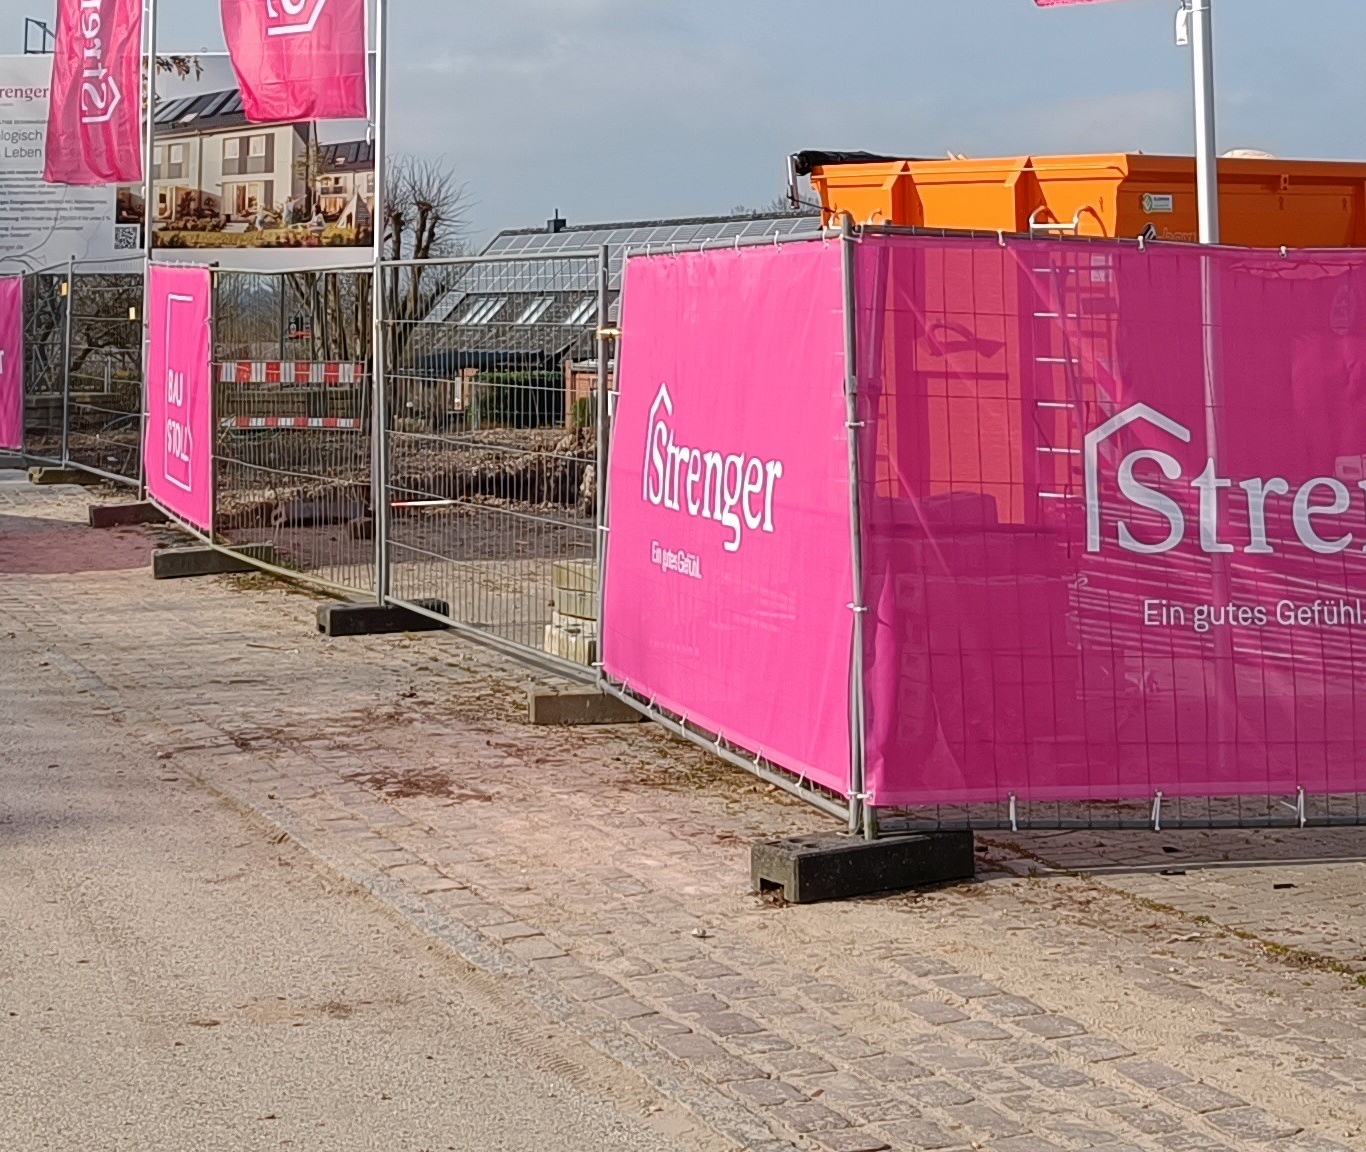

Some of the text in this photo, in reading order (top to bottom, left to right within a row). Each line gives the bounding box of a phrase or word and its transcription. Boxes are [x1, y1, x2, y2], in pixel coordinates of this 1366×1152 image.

[5, 146, 42, 158] Leben
[167, 369, 184, 407] BAU
[649, 421, 783, 552] Strenger
[1144, 600, 1186, 626] Ein
[1193, 601, 1267, 632] gutes
